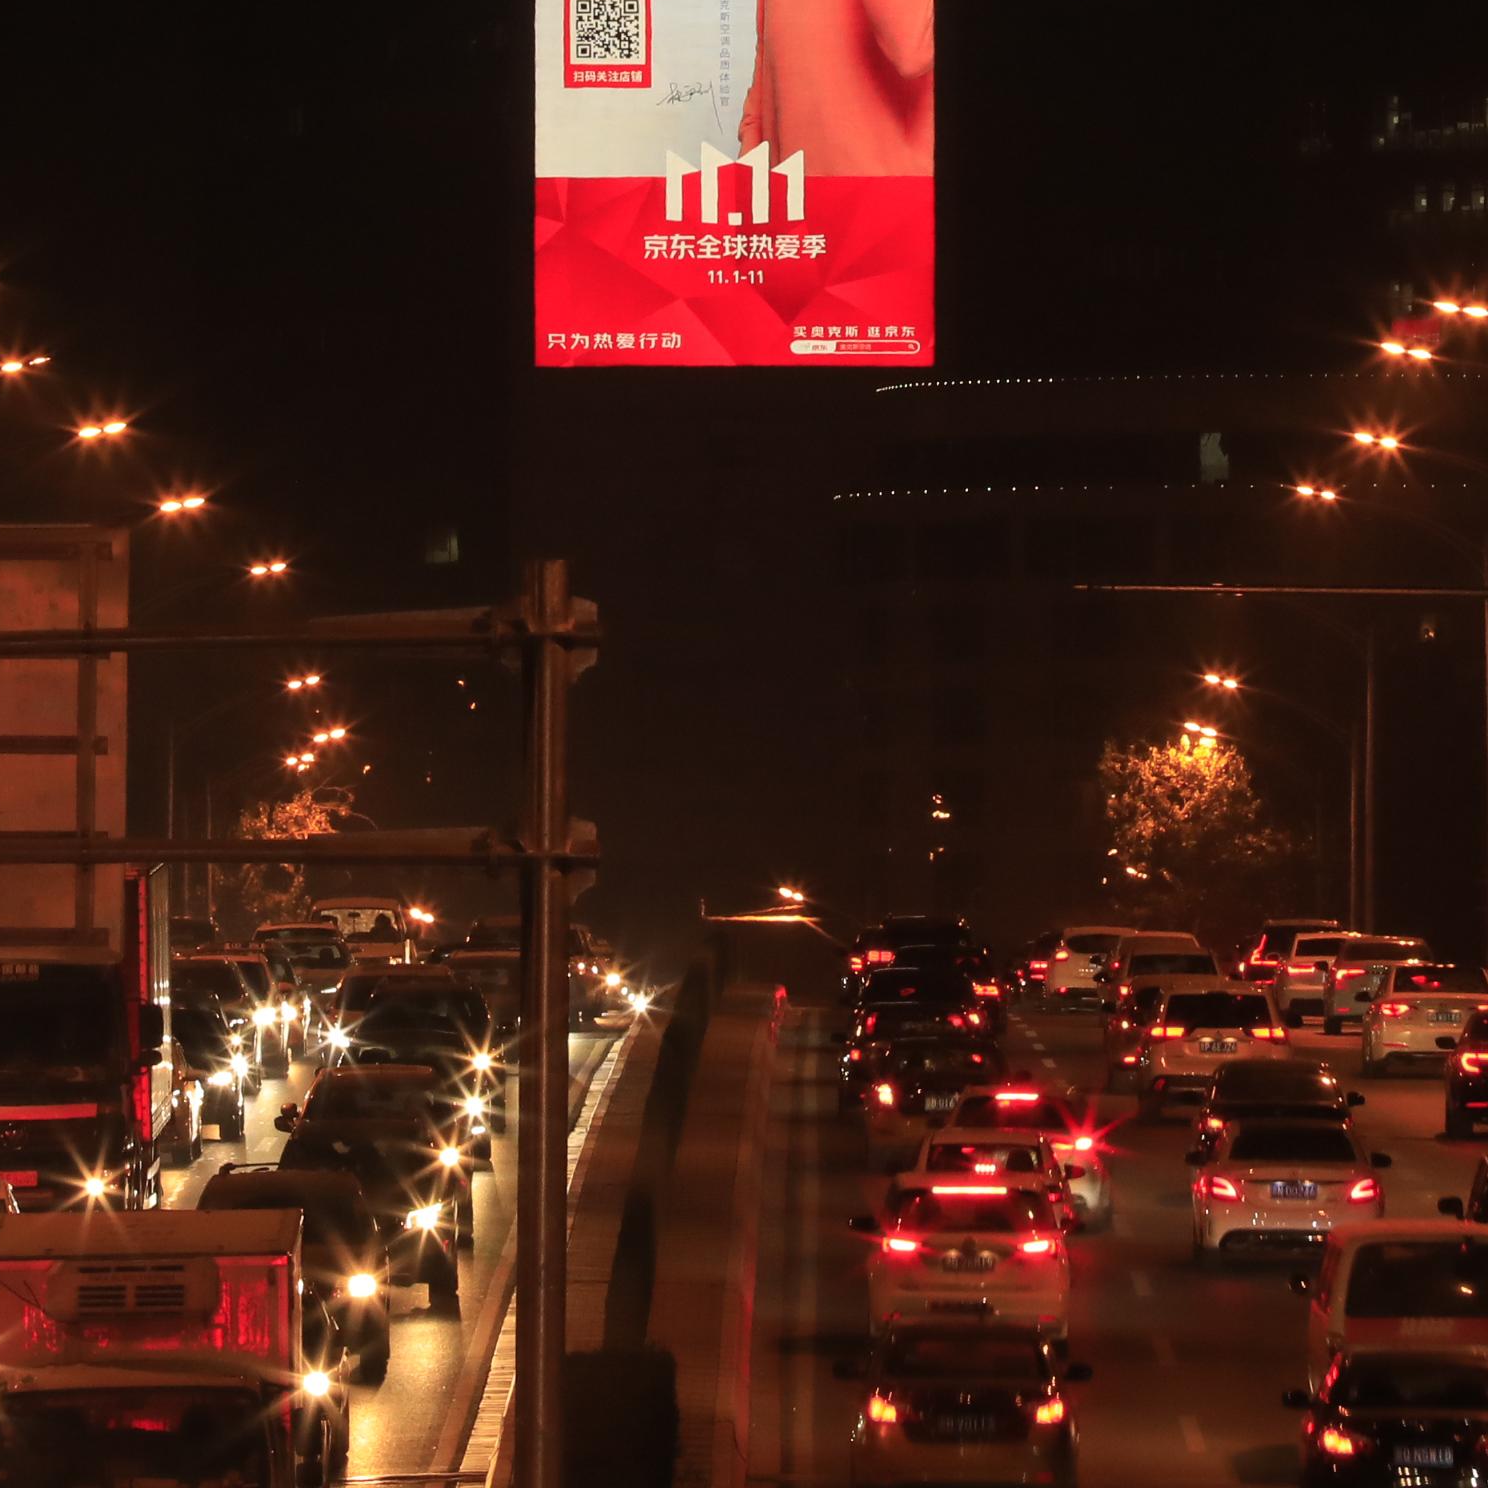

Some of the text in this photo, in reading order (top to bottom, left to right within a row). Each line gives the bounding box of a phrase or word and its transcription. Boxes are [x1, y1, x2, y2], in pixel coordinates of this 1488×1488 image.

[573, 70, 643, 83] 扫码关注店铺
[643, 234, 827, 259] 京东全球热爱季
[708, 270, 764, 284] 11.1-11
[793, 325, 916, 338] 买奥克斯 逛京东
[547, 333, 682, 350] 只为热爱行动
